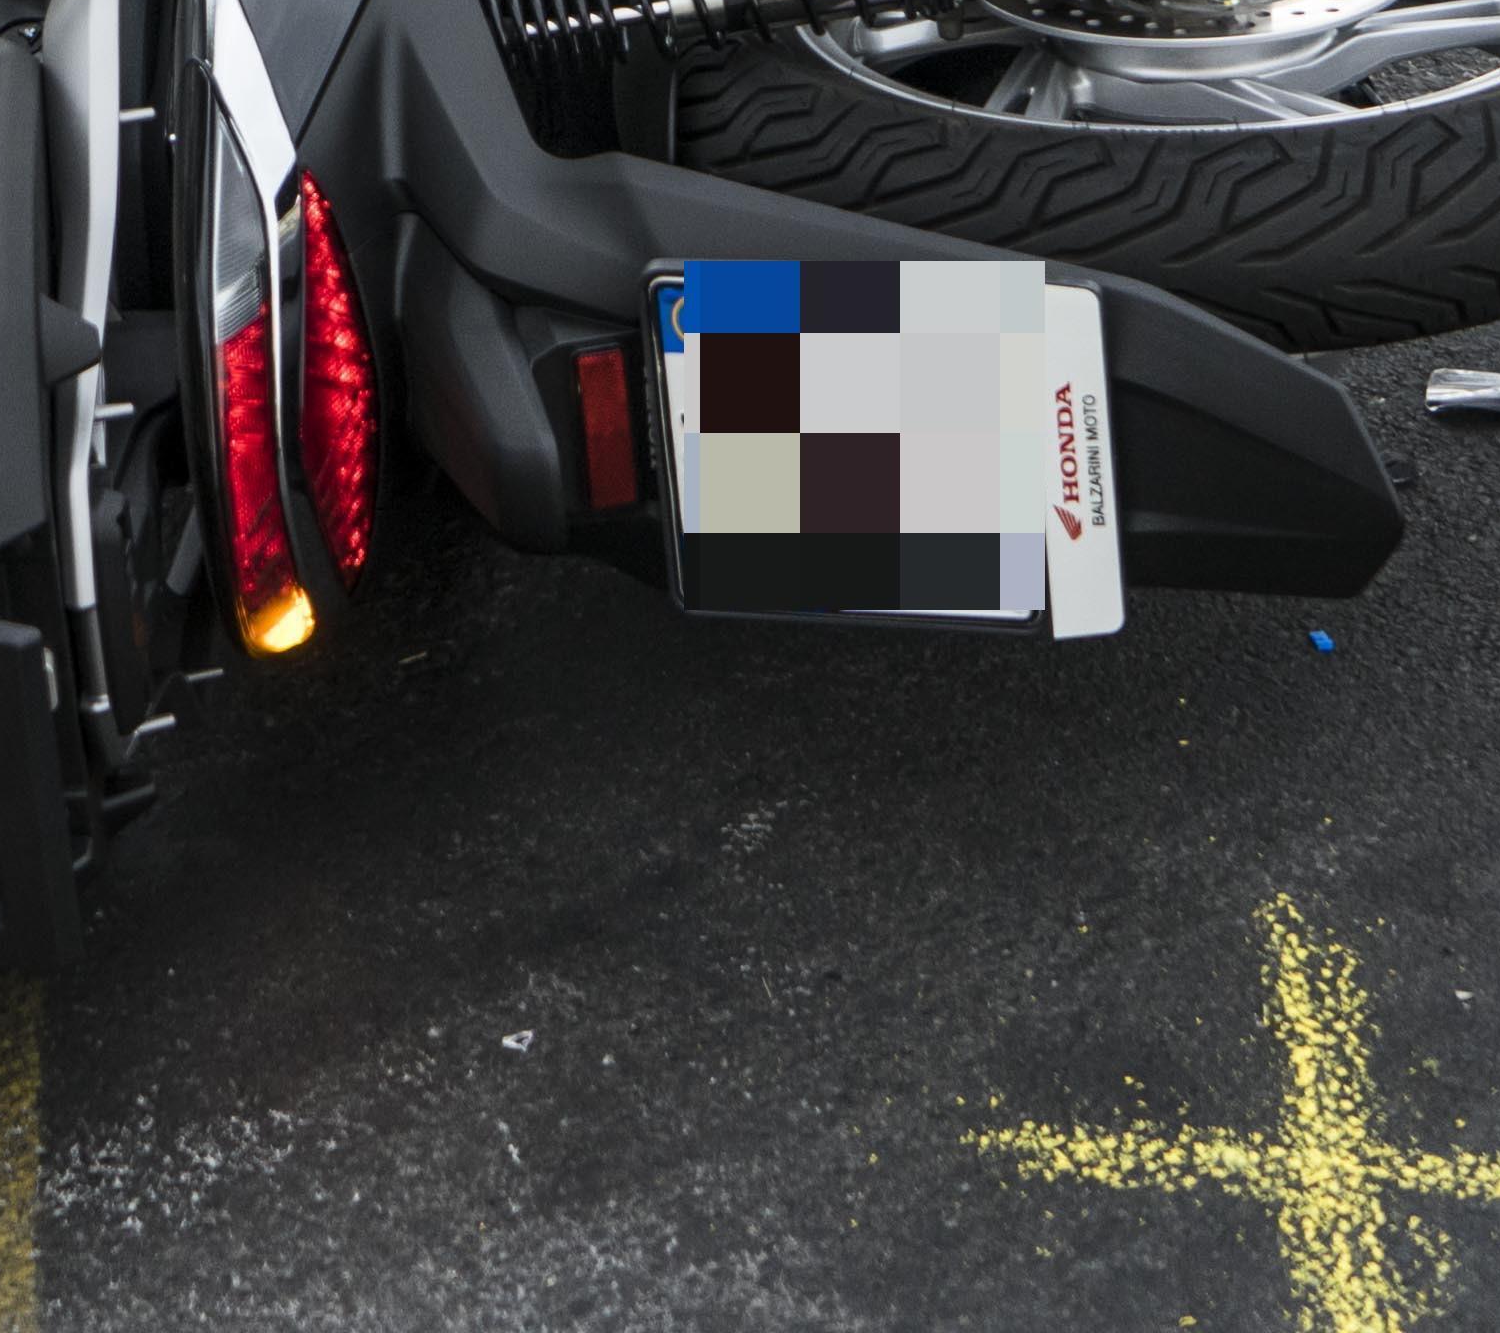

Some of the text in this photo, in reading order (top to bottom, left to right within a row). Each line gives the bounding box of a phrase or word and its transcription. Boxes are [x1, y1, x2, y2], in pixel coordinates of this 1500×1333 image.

[1055, 380, 1080, 504] HONDA
[1081, 393, 1106, 527] BALZARINI MOTO
